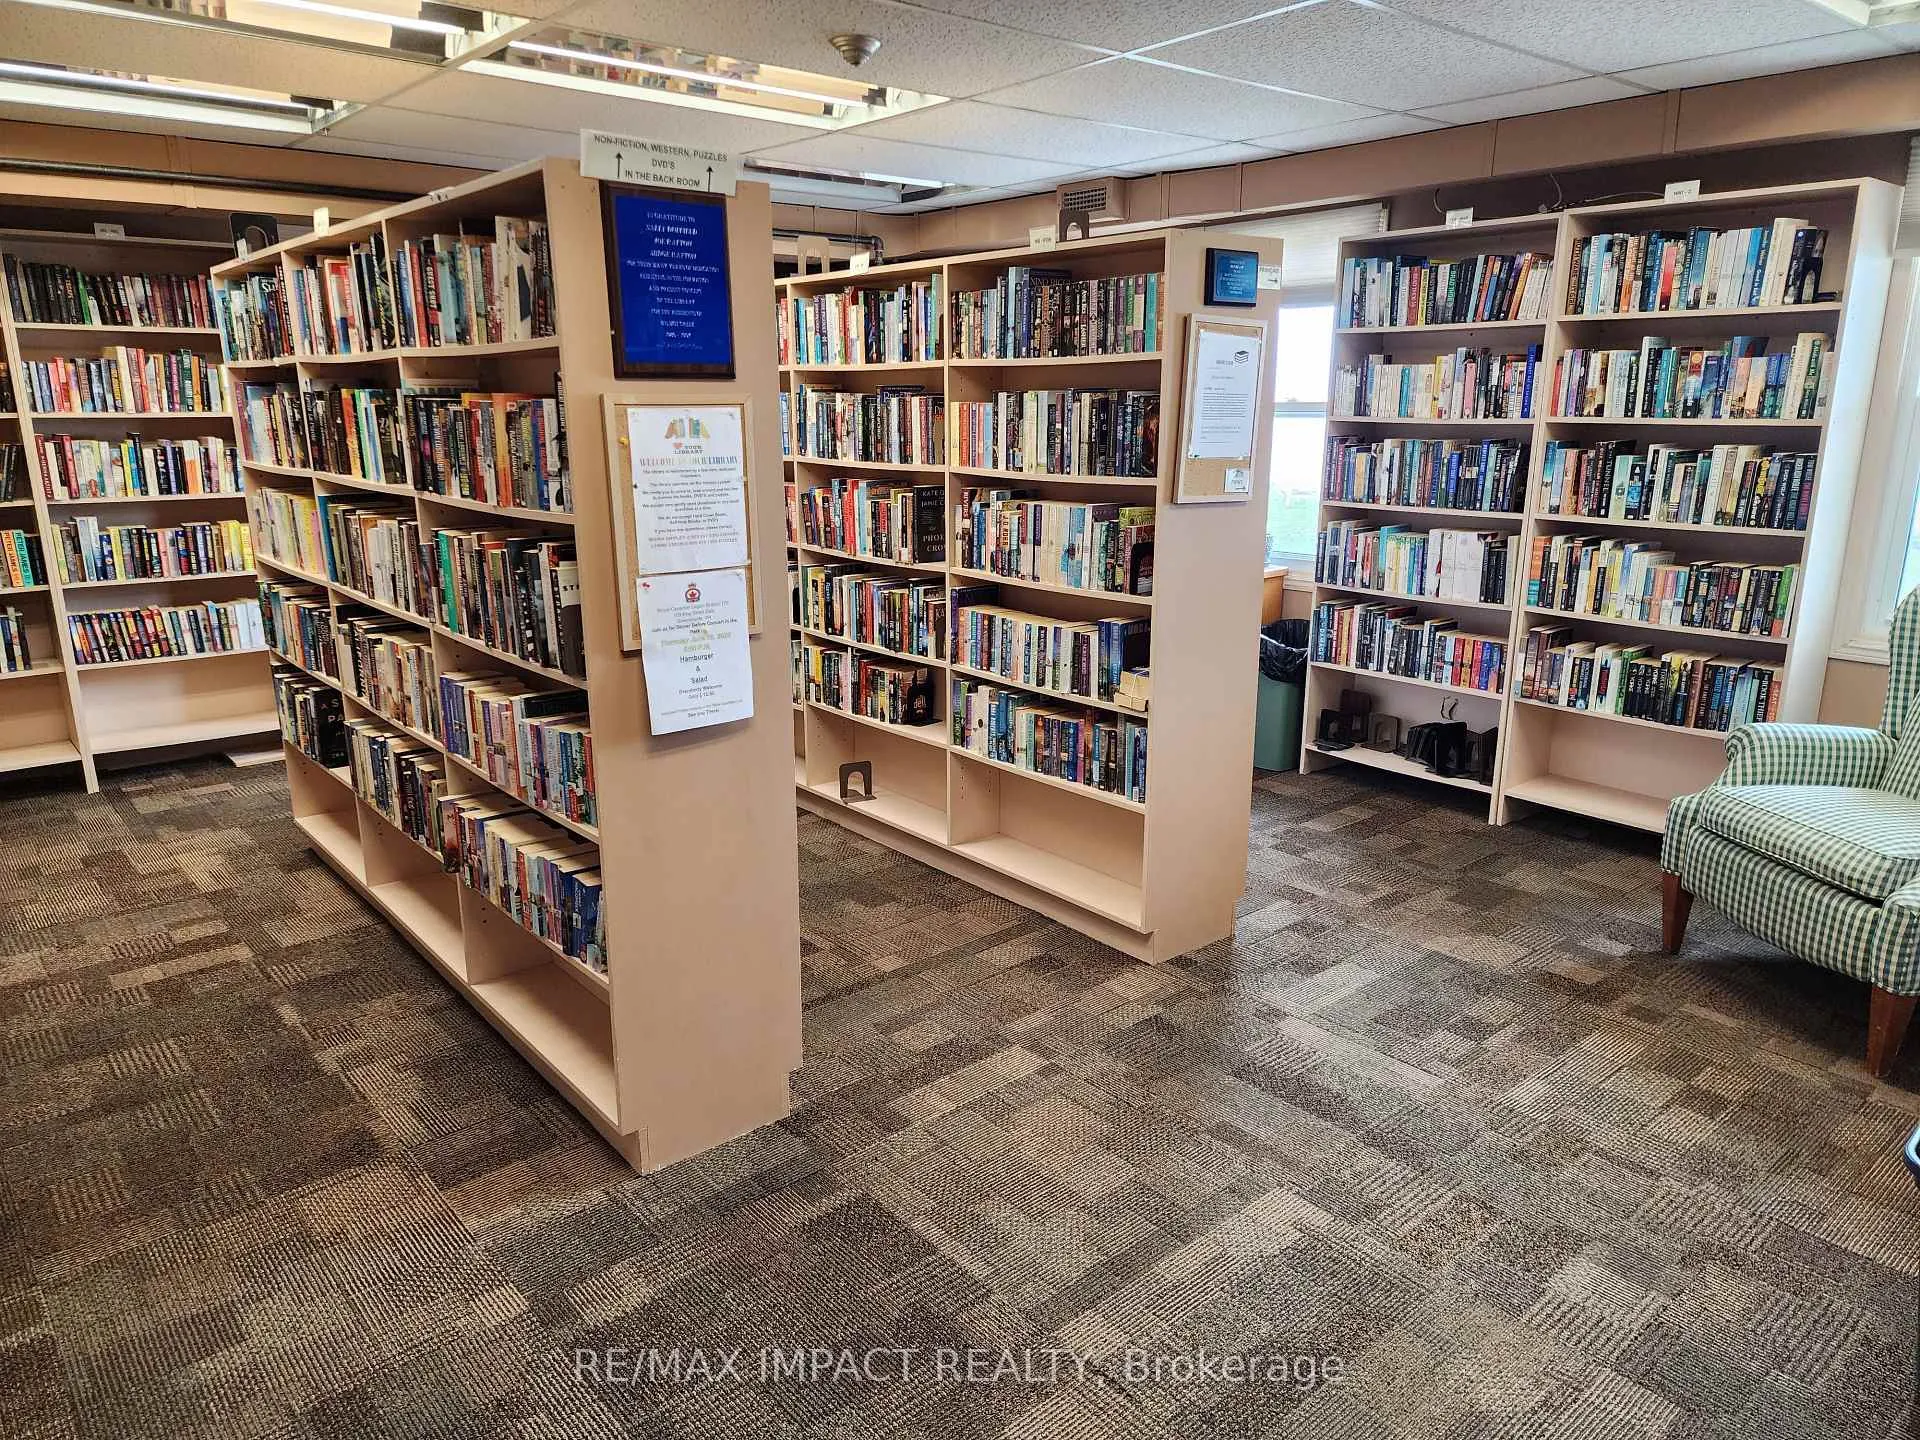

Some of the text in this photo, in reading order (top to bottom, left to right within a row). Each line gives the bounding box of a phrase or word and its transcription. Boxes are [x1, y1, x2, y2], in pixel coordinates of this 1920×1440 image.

[594, 135, 728, 162] NON-FICTION, WESTERN, PUZZLES
[652, 158, 675, 169] DVD'S
[625, 169, 700, 187] IN THE BACK ROOM
[1602, 460, 1613, 493] TUNNEL
[922, 489, 938, 497] KATE
[921, 500, 938, 508] JAMIE
[961, 490, 970, 518] RIVERS
[20, 553, 29, 574] JAMES
[680, 653, 714, 663] Hamburger
[691, 675, 708, 684] Salad
[1755, 680, 1769, 723] BOOK THIEF
